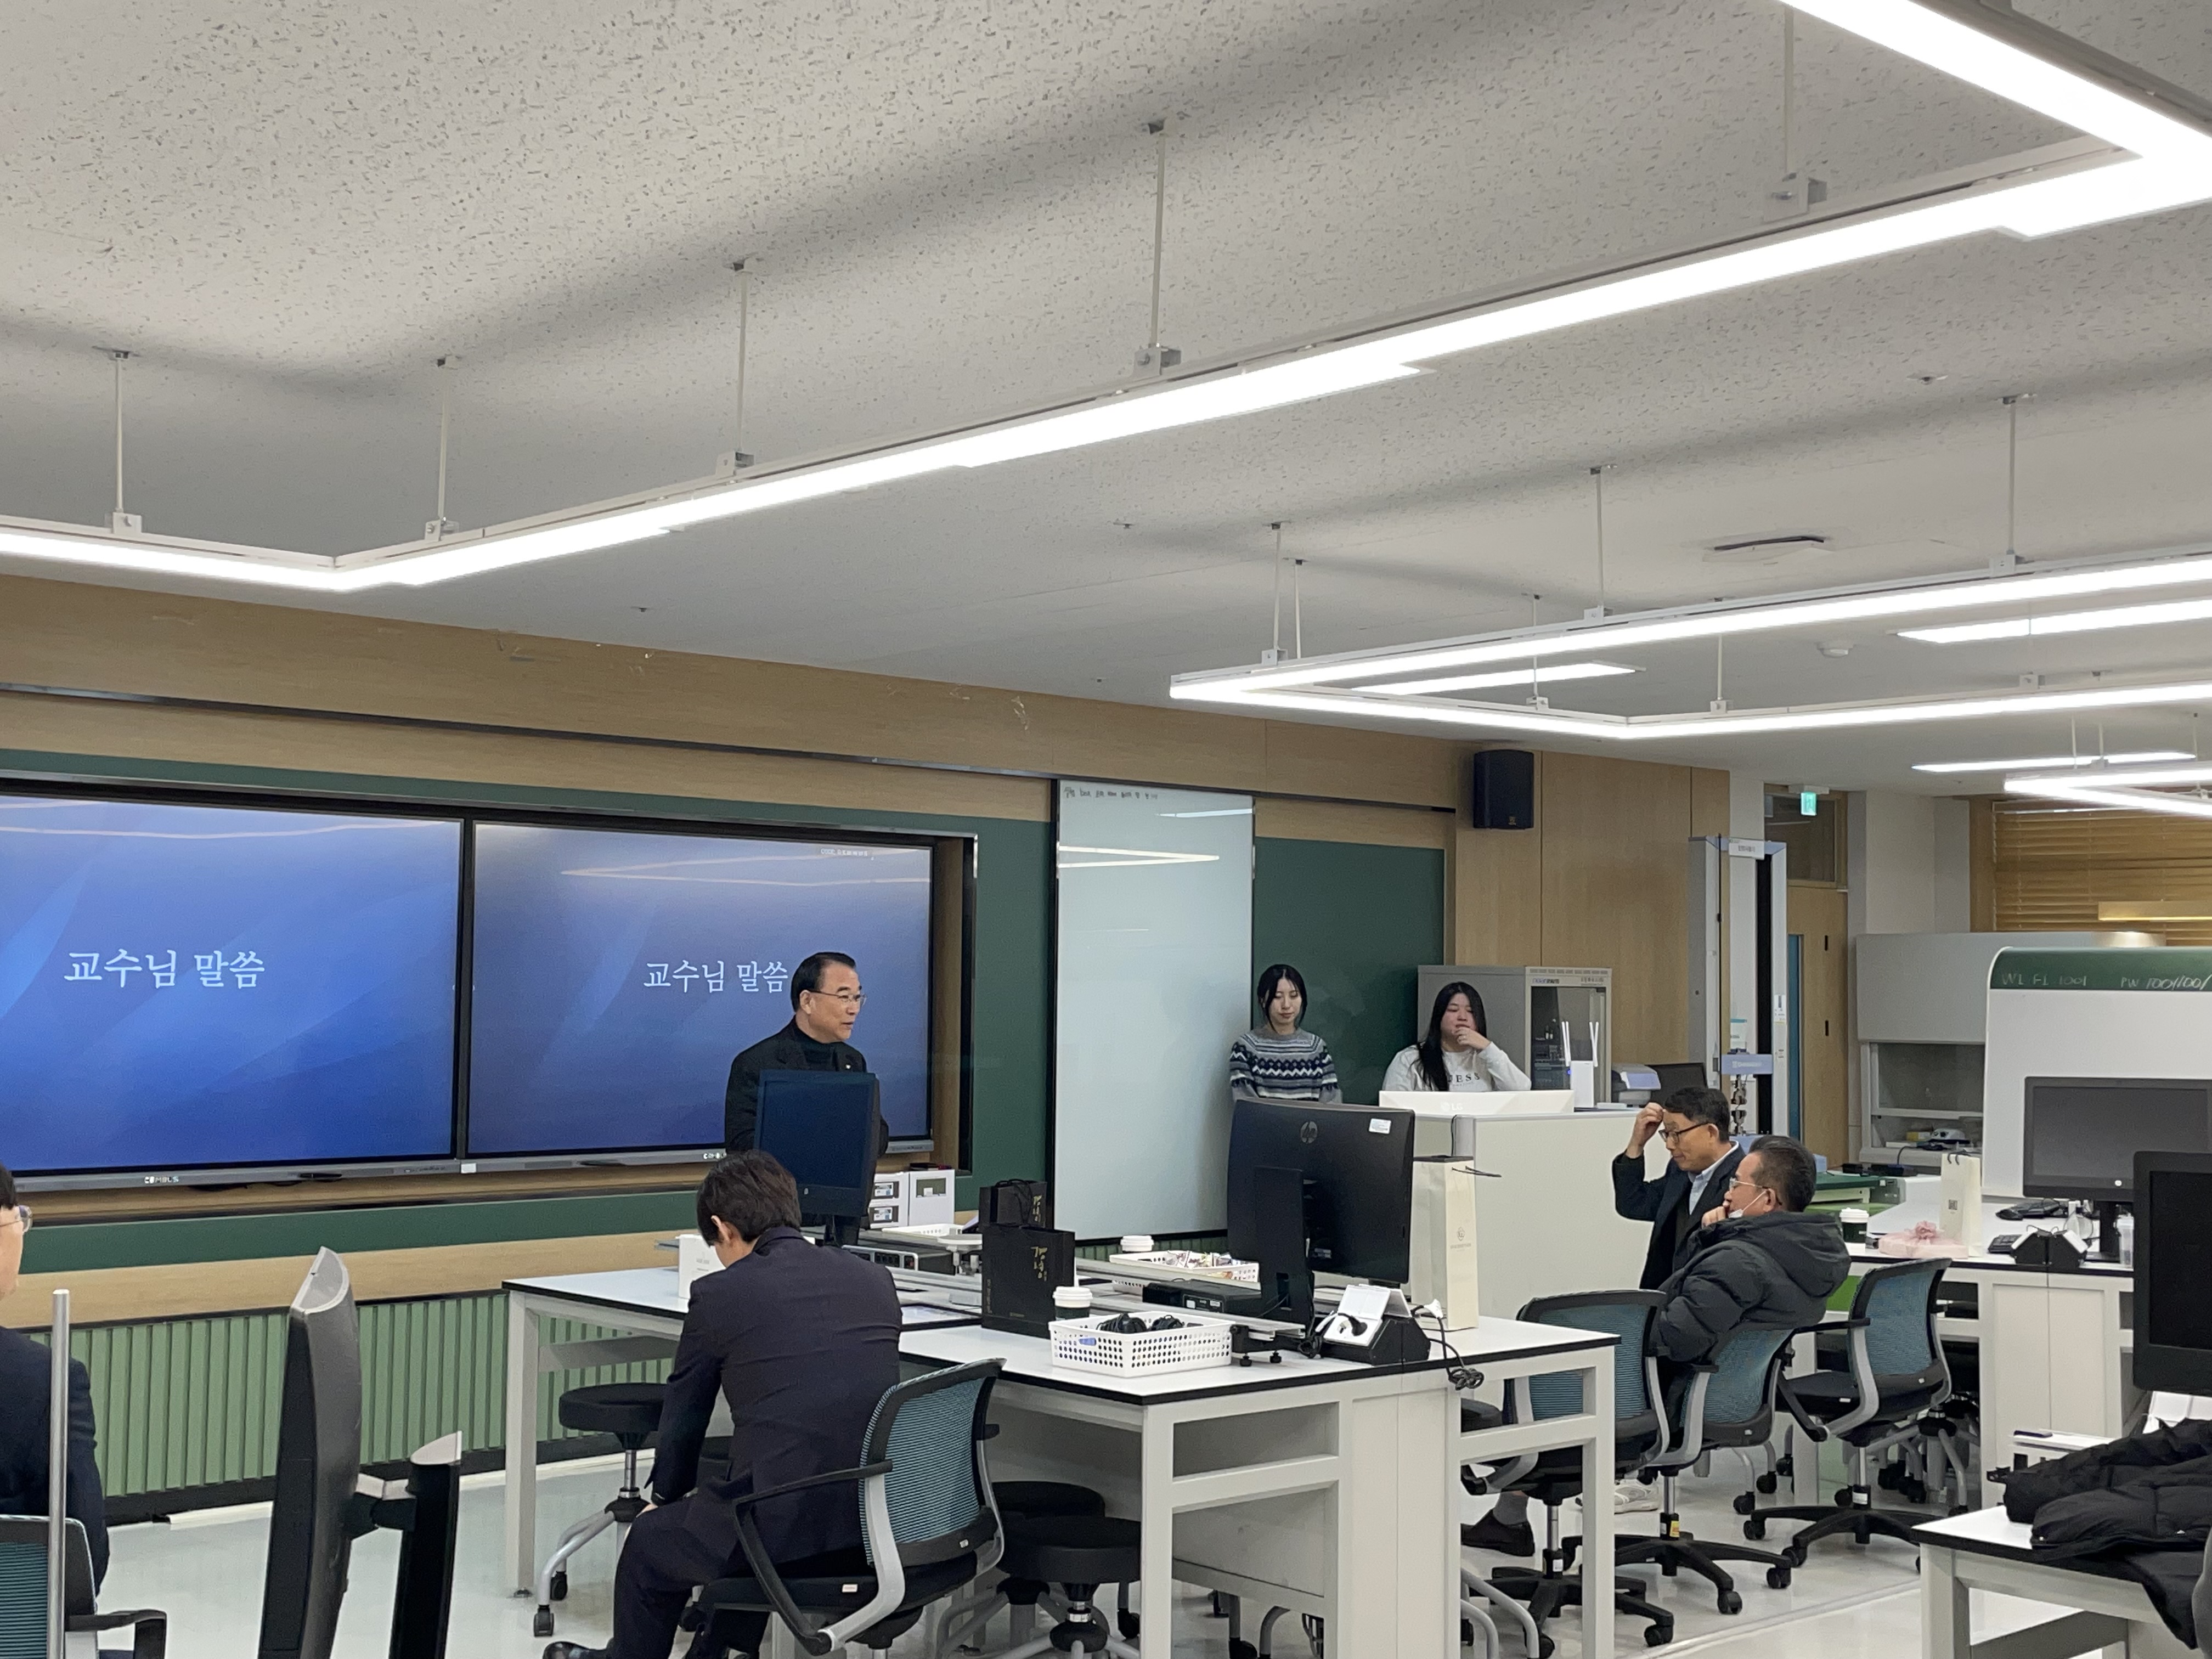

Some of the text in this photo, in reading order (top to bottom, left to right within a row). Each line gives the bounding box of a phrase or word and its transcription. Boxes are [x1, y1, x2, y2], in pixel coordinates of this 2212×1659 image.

[64, 949, 265, 989] 교수님 말씀
[644, 960, 788, 994] 교수님 말씀
